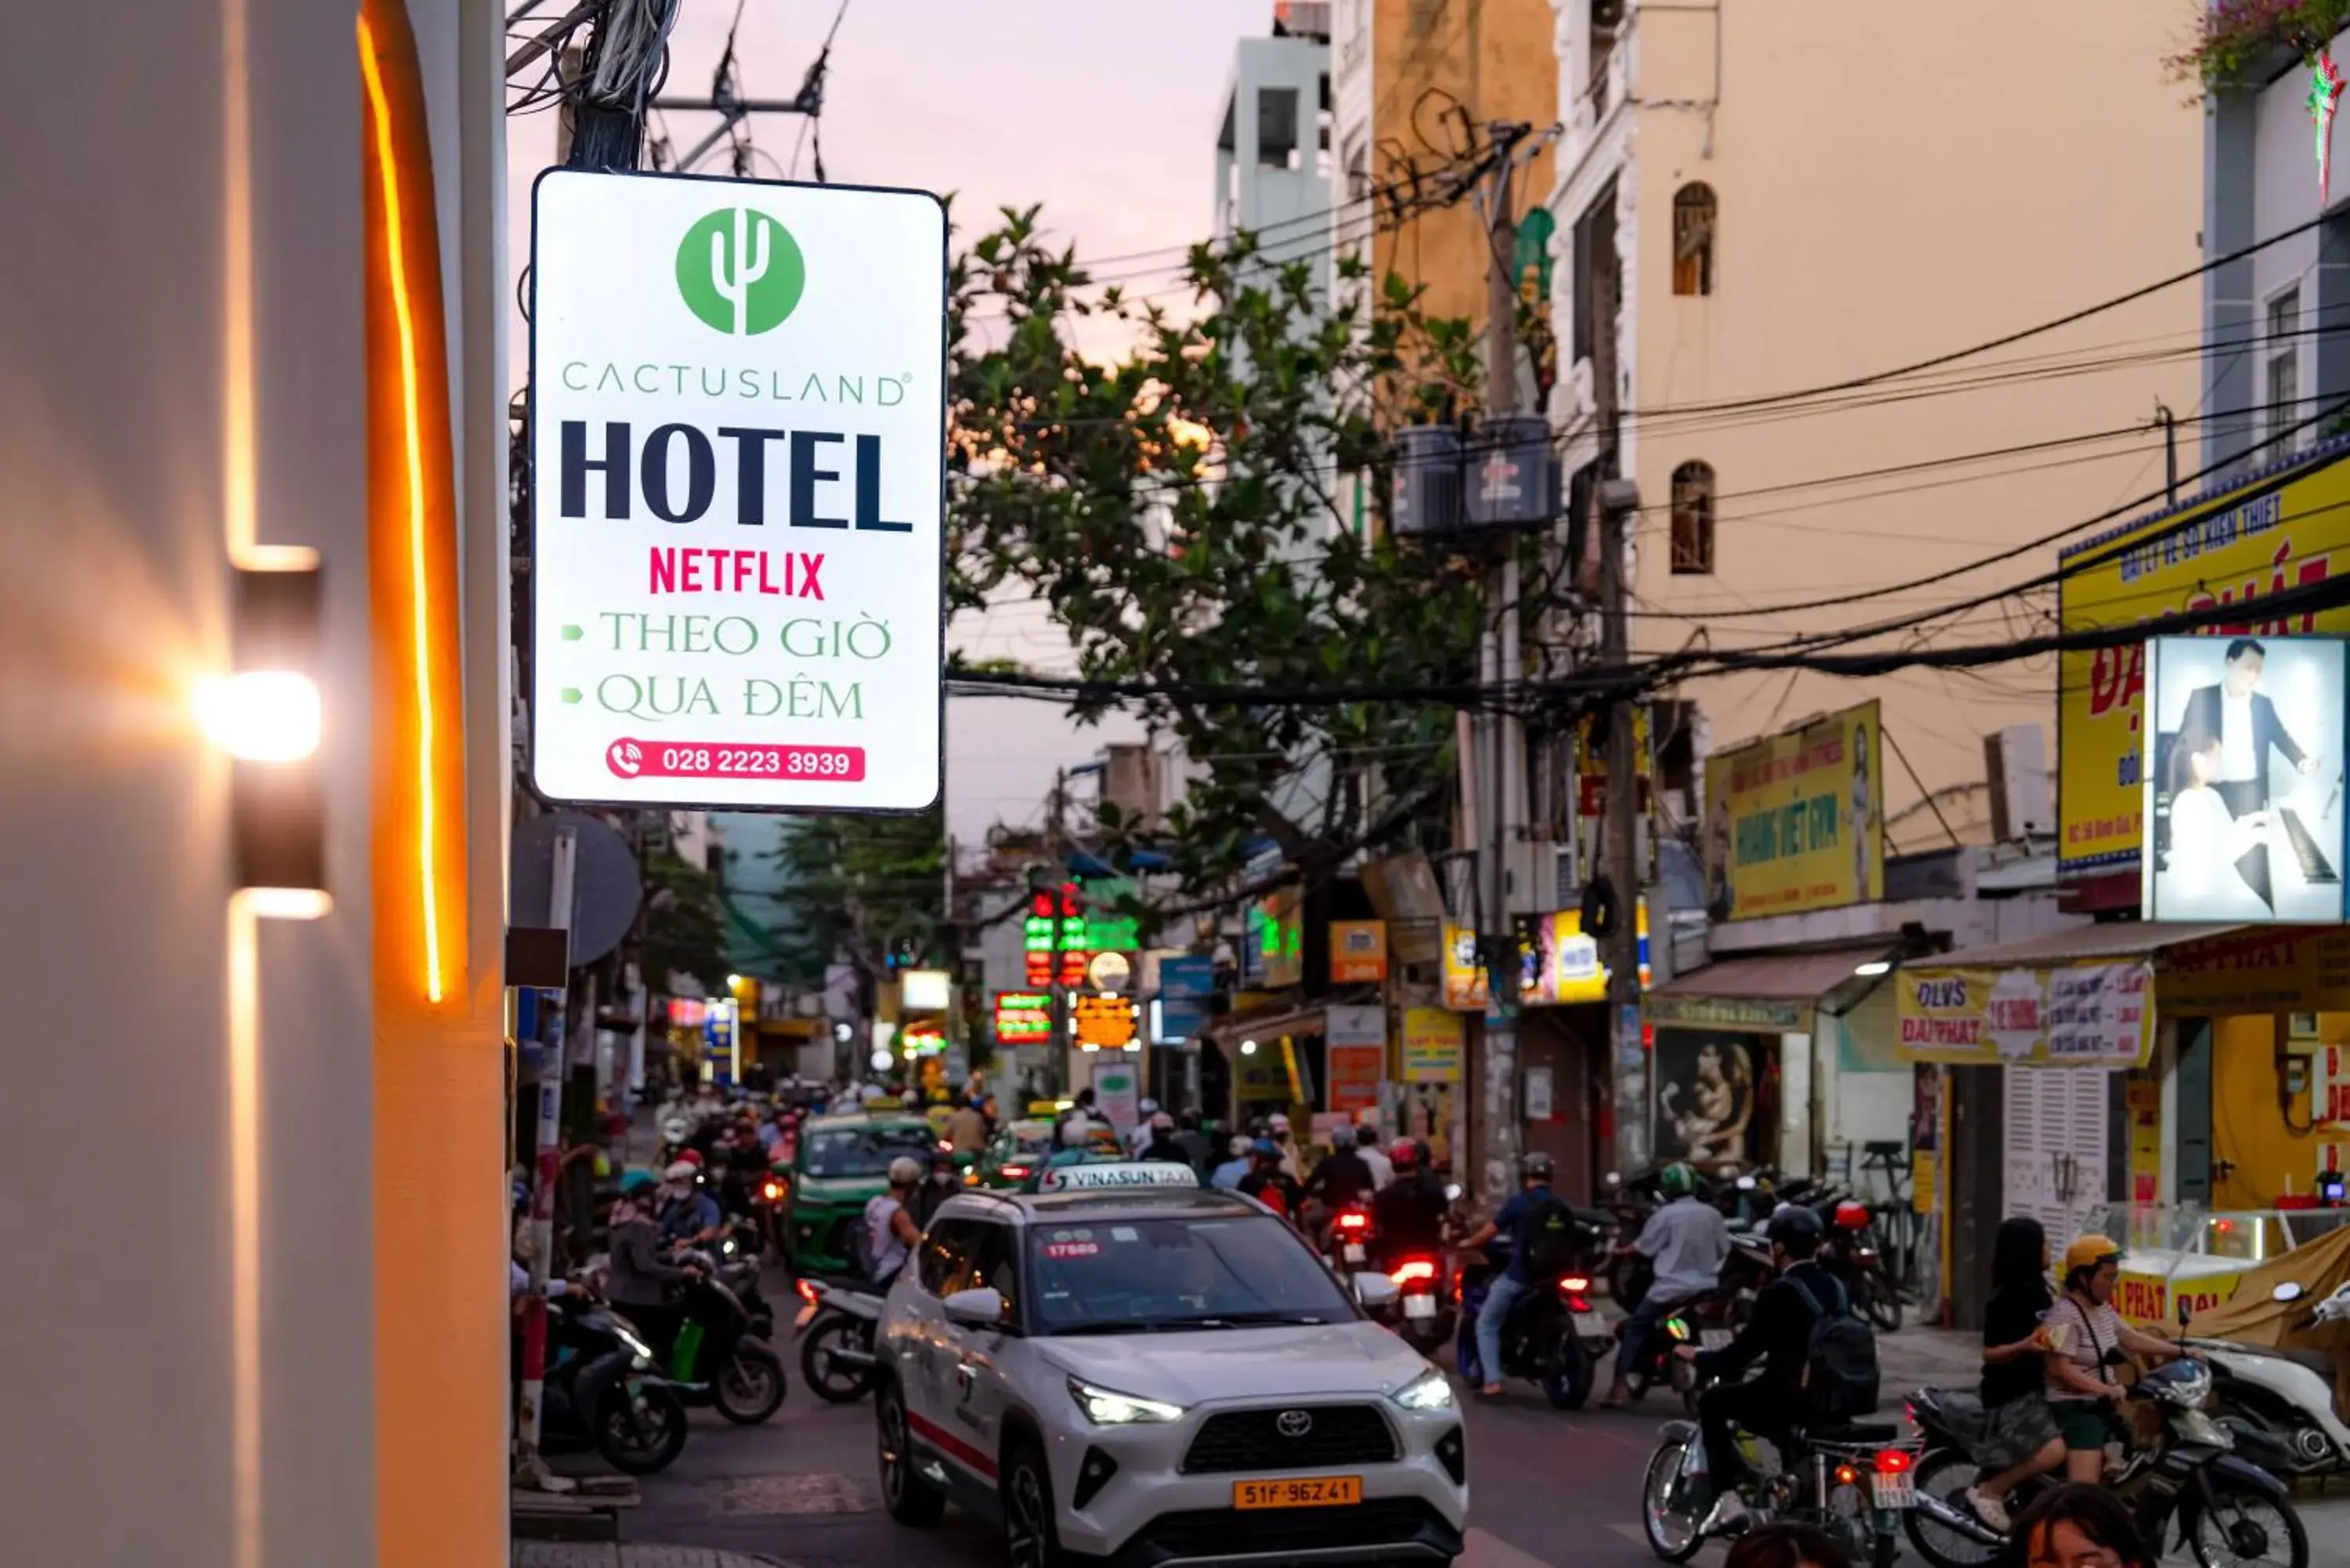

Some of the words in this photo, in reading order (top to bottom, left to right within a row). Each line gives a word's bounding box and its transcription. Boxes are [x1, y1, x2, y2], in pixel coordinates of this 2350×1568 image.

[562, 361, 905, 406] CACTUSLAND
[560, 420, 913, 533] HOTEL
[649, 547, 825, 601] NETFLIX
[600, 612, 759, 655] THEO
[781, 611, 892, 659] GIỜ
[597, 674, 721, 722] QUA
[743, 672, 864, 720] ĐÊM
[663, 749, 710, 771] 028
[717, 750, 780, 773] 2223
[787, 752, 850, 775] 3939
[1073, 1170, 1155, 1187] VINASUN
